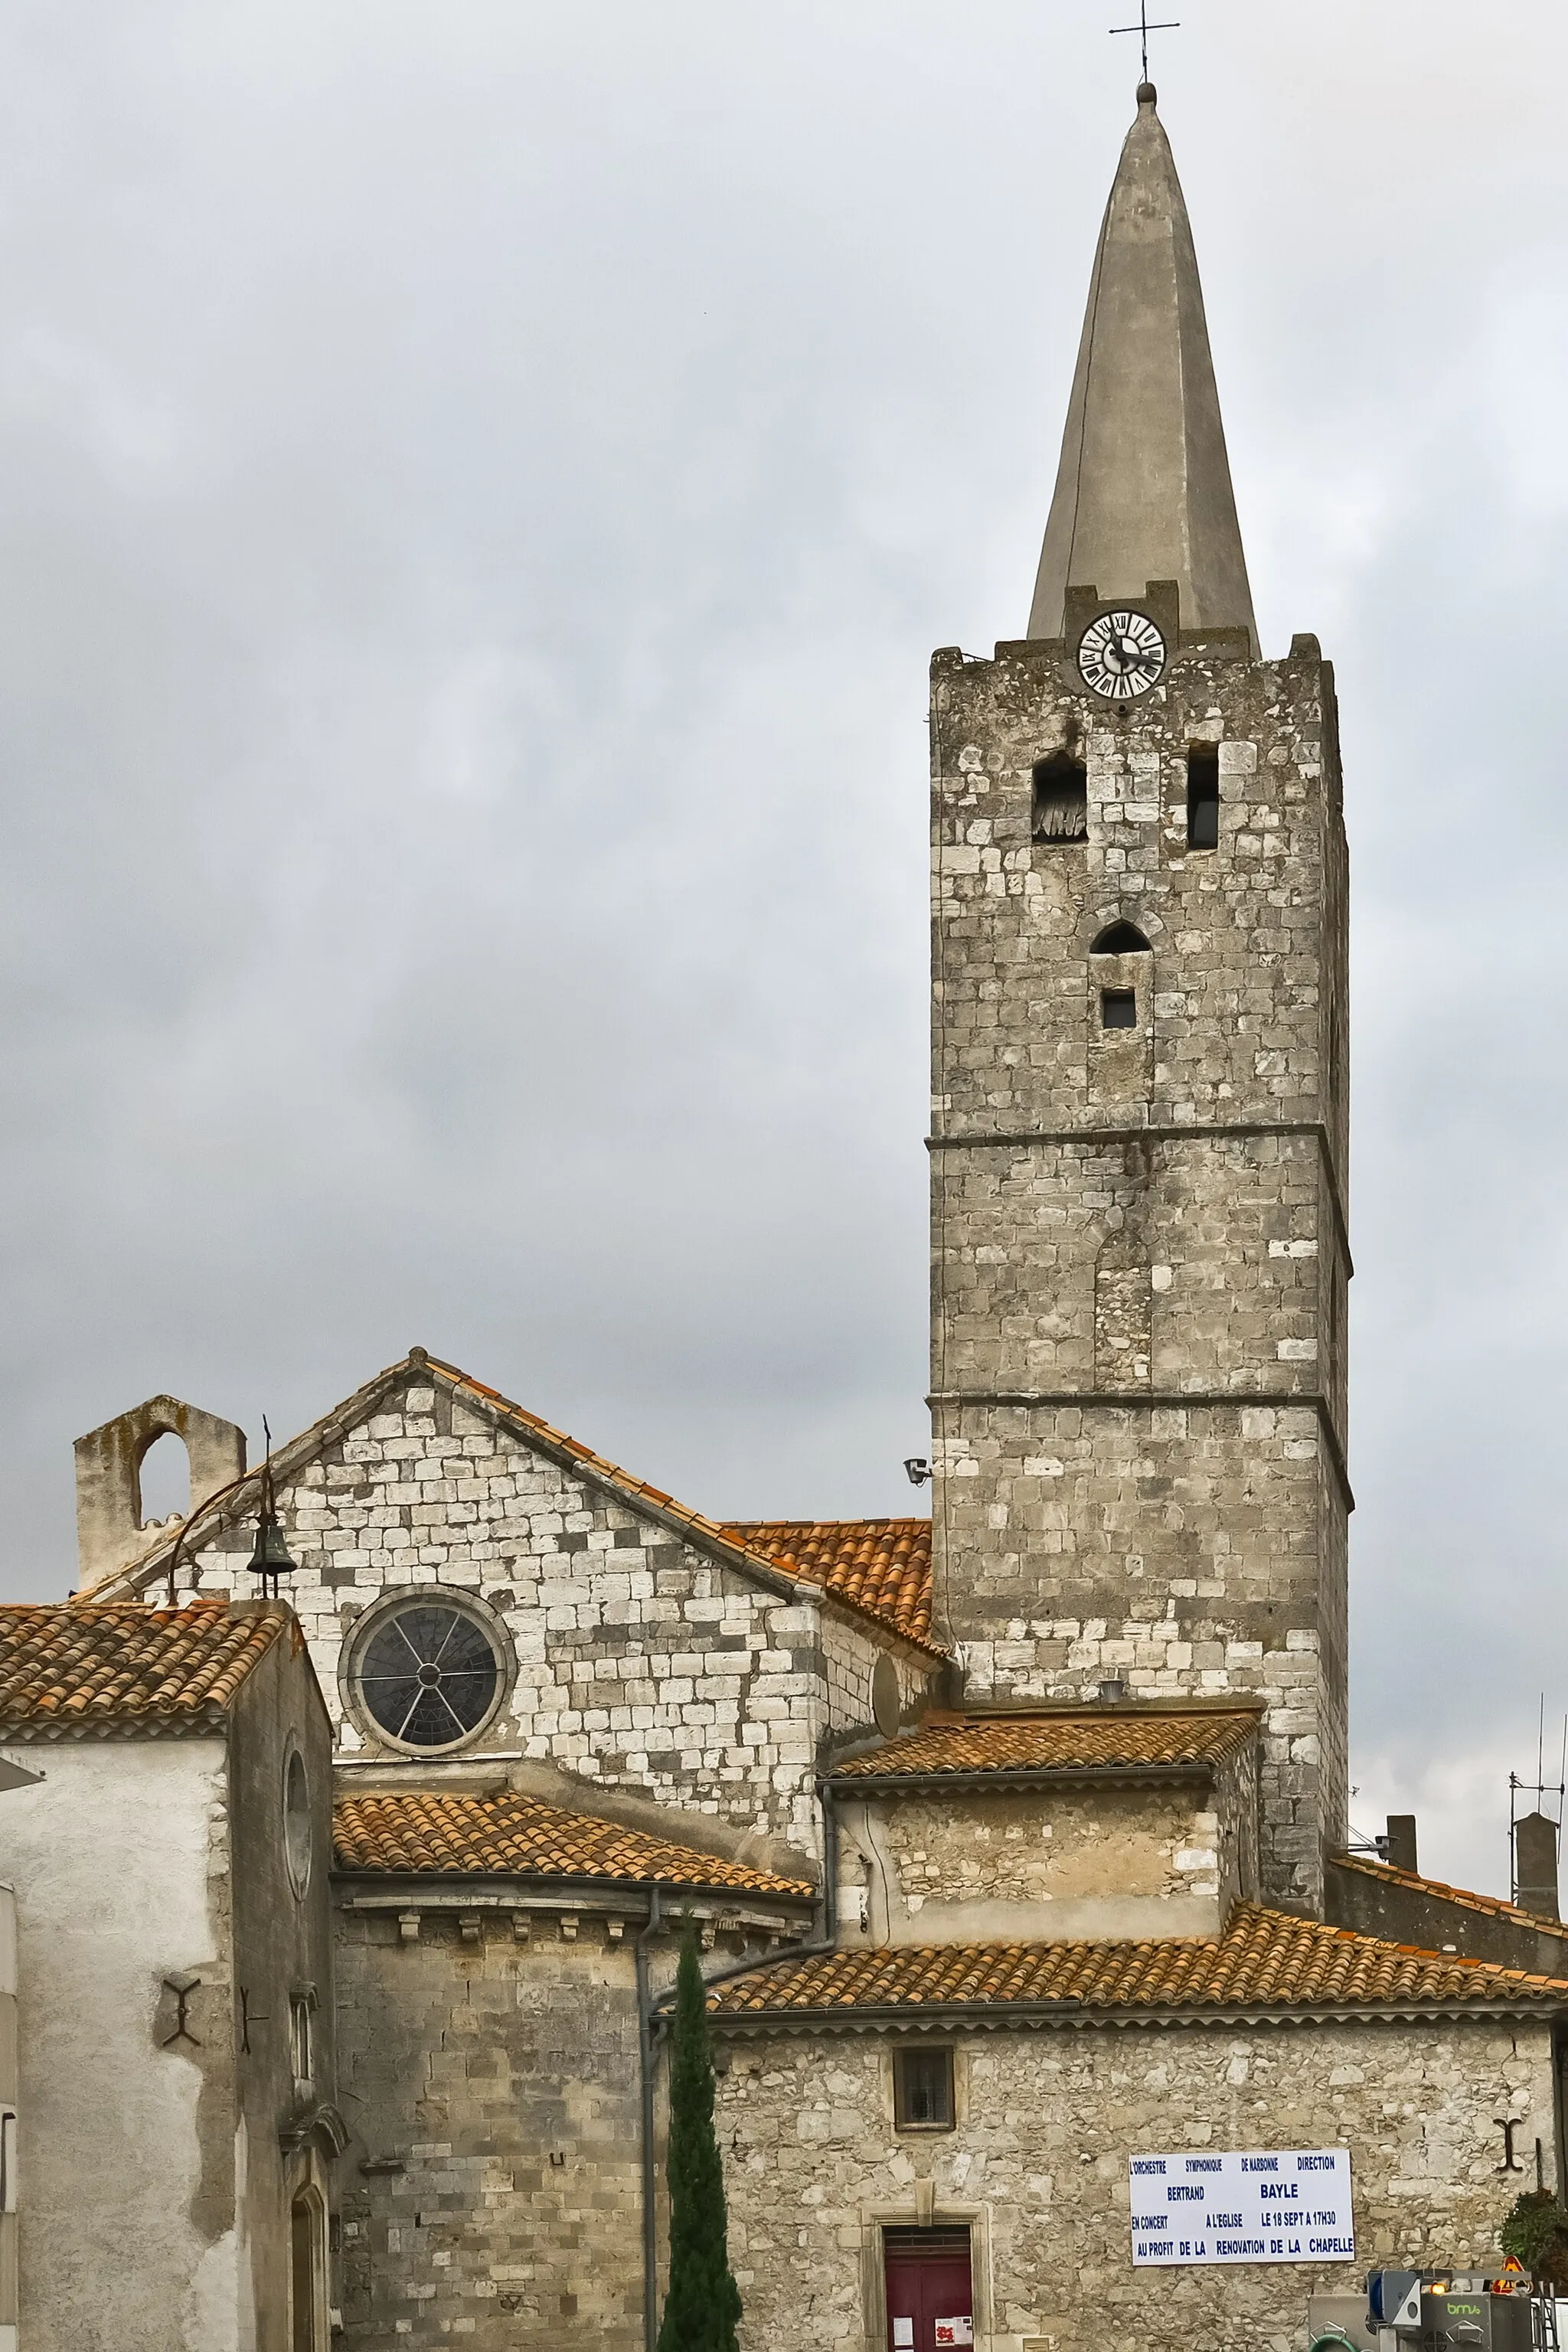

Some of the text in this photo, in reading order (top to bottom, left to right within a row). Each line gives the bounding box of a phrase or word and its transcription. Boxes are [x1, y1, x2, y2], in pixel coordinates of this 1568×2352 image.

[1116, 616, 1125, 629] XII
[1086, 635, 1099, 646] X
[1144, 632, 1156, 642] II
[1082, 653, 1096, 662] IX
[1135, 678, 1145, 691] V
[1129, 2156, 1334, 2174] L'ORCHESTRE SYMPHONIQUE DE NARBONNE DIRECTION
[1168, 2184, 1298, 2201] BERTRAND BAYLE
[1132, 2211, 1335, 2230] EN CONCERT A L'EGLISE LE 18 SEPT A 17H30
[1138, 2238, 1353, 2256] AU PROFIT DE LA RENOVATION DE LA CHAPELLE
